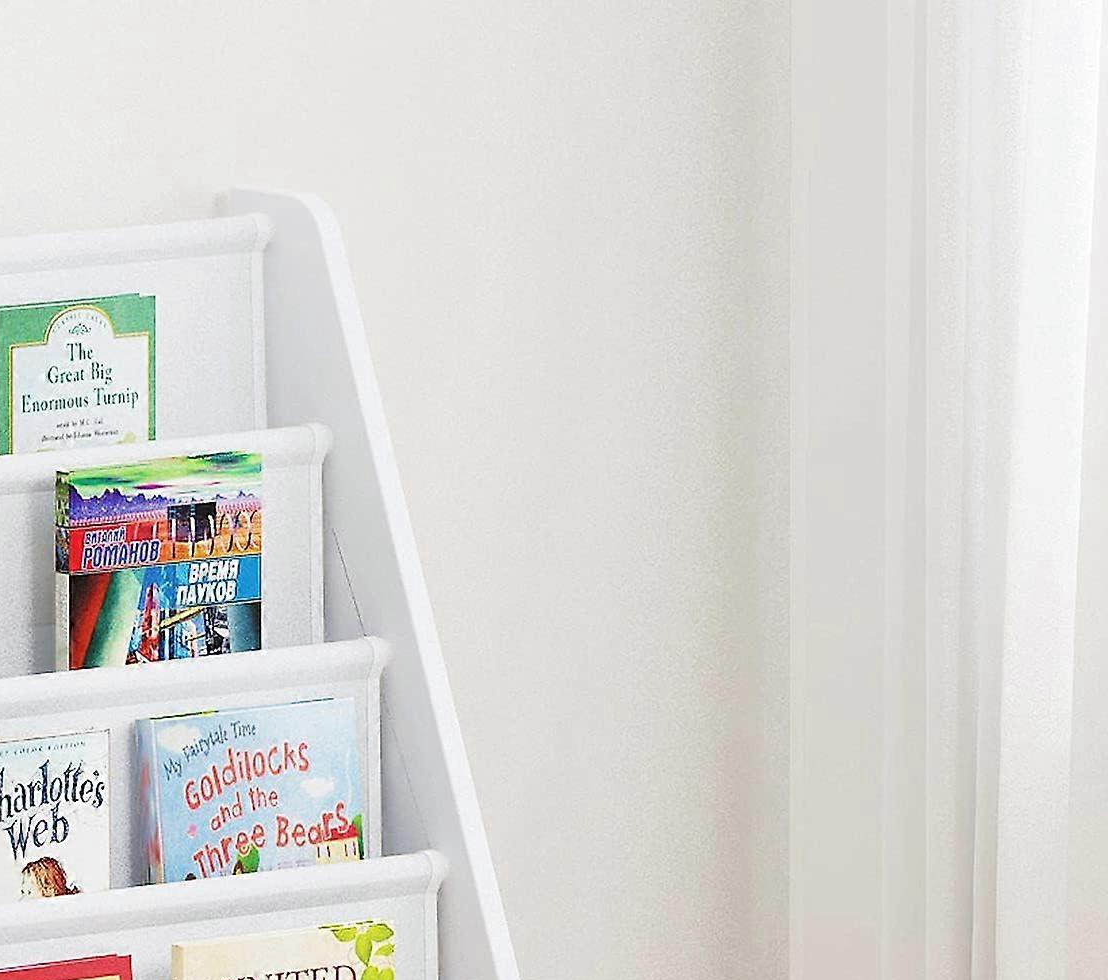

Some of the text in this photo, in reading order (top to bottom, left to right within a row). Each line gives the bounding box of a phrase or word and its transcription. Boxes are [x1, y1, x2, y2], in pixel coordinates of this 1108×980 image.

[67, 343, 93, 361] The
[47, 362, 113, 385] Great Big
[22, 387, 139, 413] Enormous Turnip
[82, 540, 161, 569] РОМАНОВ
[188, 558, 240, 584] ВРЕМЯ
[176, 580, 238, 606] ПАУКОВ
[163, 720, 257, 781] My Fairytale Time
[184, 740, 310, 811] Goldilocks
[211, 787, 279, 831] and the
[4, 802, 70, 860] Web
[193, 801, 350, 879] Three Bears
